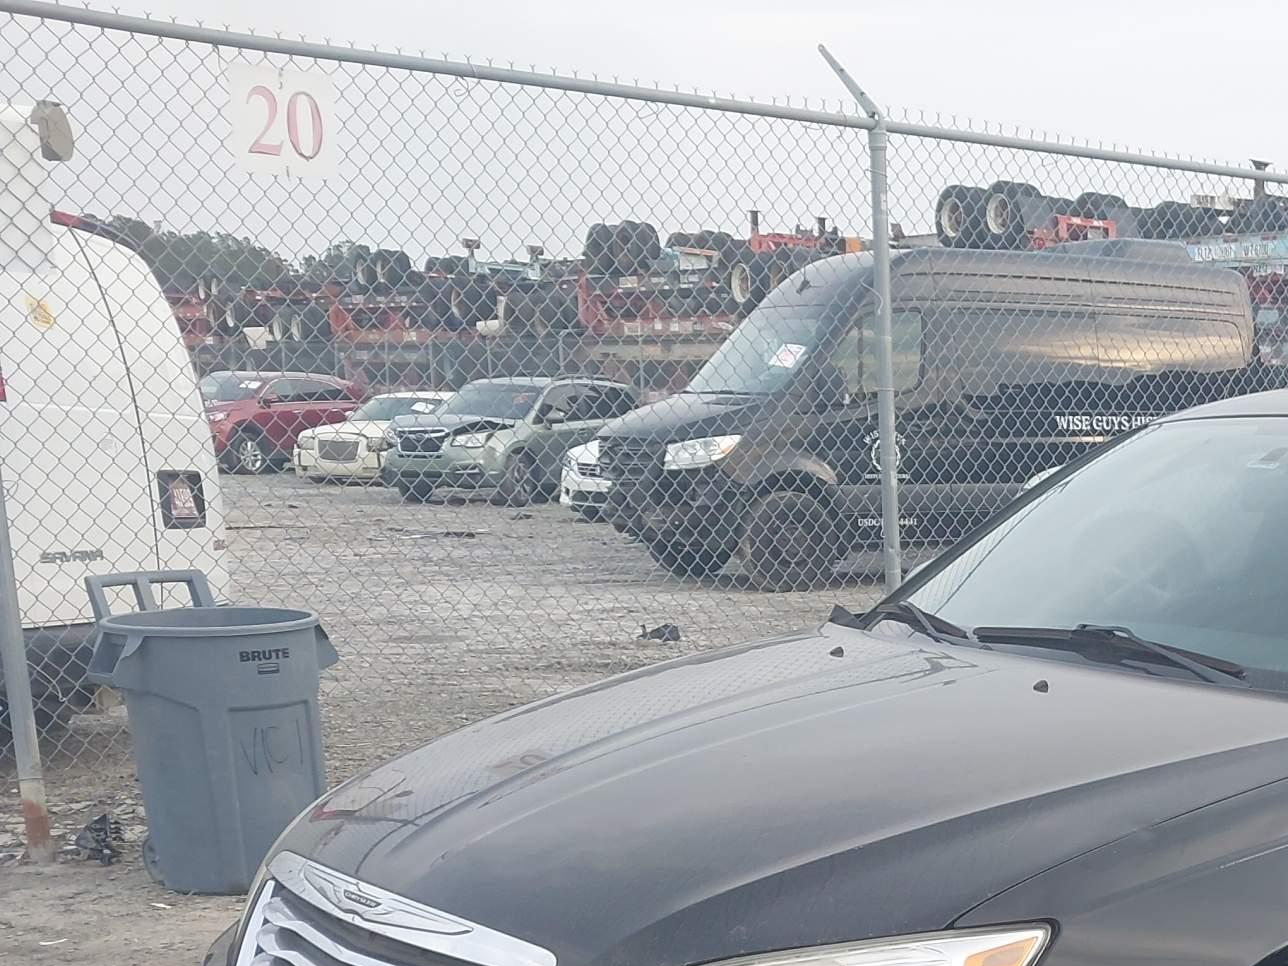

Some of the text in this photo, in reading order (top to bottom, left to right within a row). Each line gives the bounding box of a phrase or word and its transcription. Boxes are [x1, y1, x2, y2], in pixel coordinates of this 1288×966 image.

[245, 85, 323, 161] 20
[1055, 416, 1090, 430] WISE
[1093, 416, 1129, 430] GUYS
[40, 549, 104, 563] SAVANA
[239, 647, 290, 662] BRUTE
